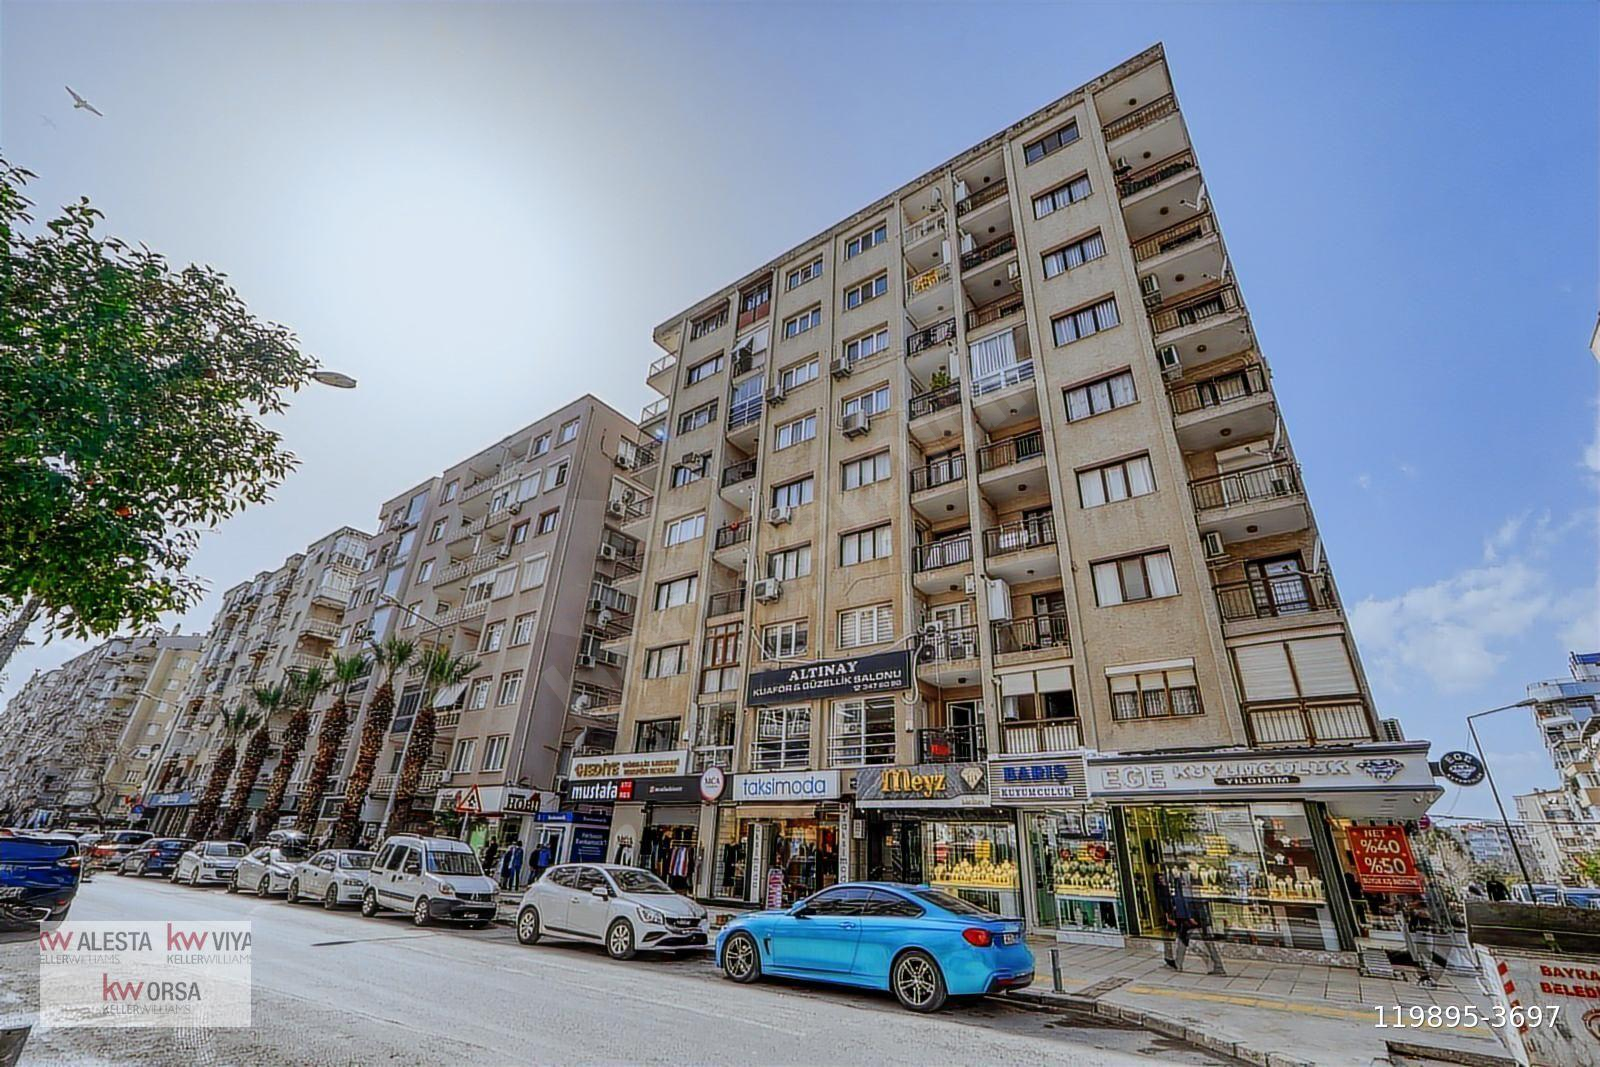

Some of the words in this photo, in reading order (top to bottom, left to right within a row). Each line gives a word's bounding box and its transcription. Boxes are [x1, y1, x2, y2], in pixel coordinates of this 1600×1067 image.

[788, 660, 858, 682] ALTINAY
[853, 669, 902, 684] SALONU
[743, 776, 826, 796] taksimoda
[880, 768, 946, 798] Meyz
[1100, 765, 1167, 790] EGE
[1225, 776, 1290, 785] YILDIRIM
[571, 780, 618, 800] mustafa
[1001, 786, 1073, 798] KUYUMCULUK
[1360, 839, 1400, 854] %40
[1364, 857, 1406, 874] %50
